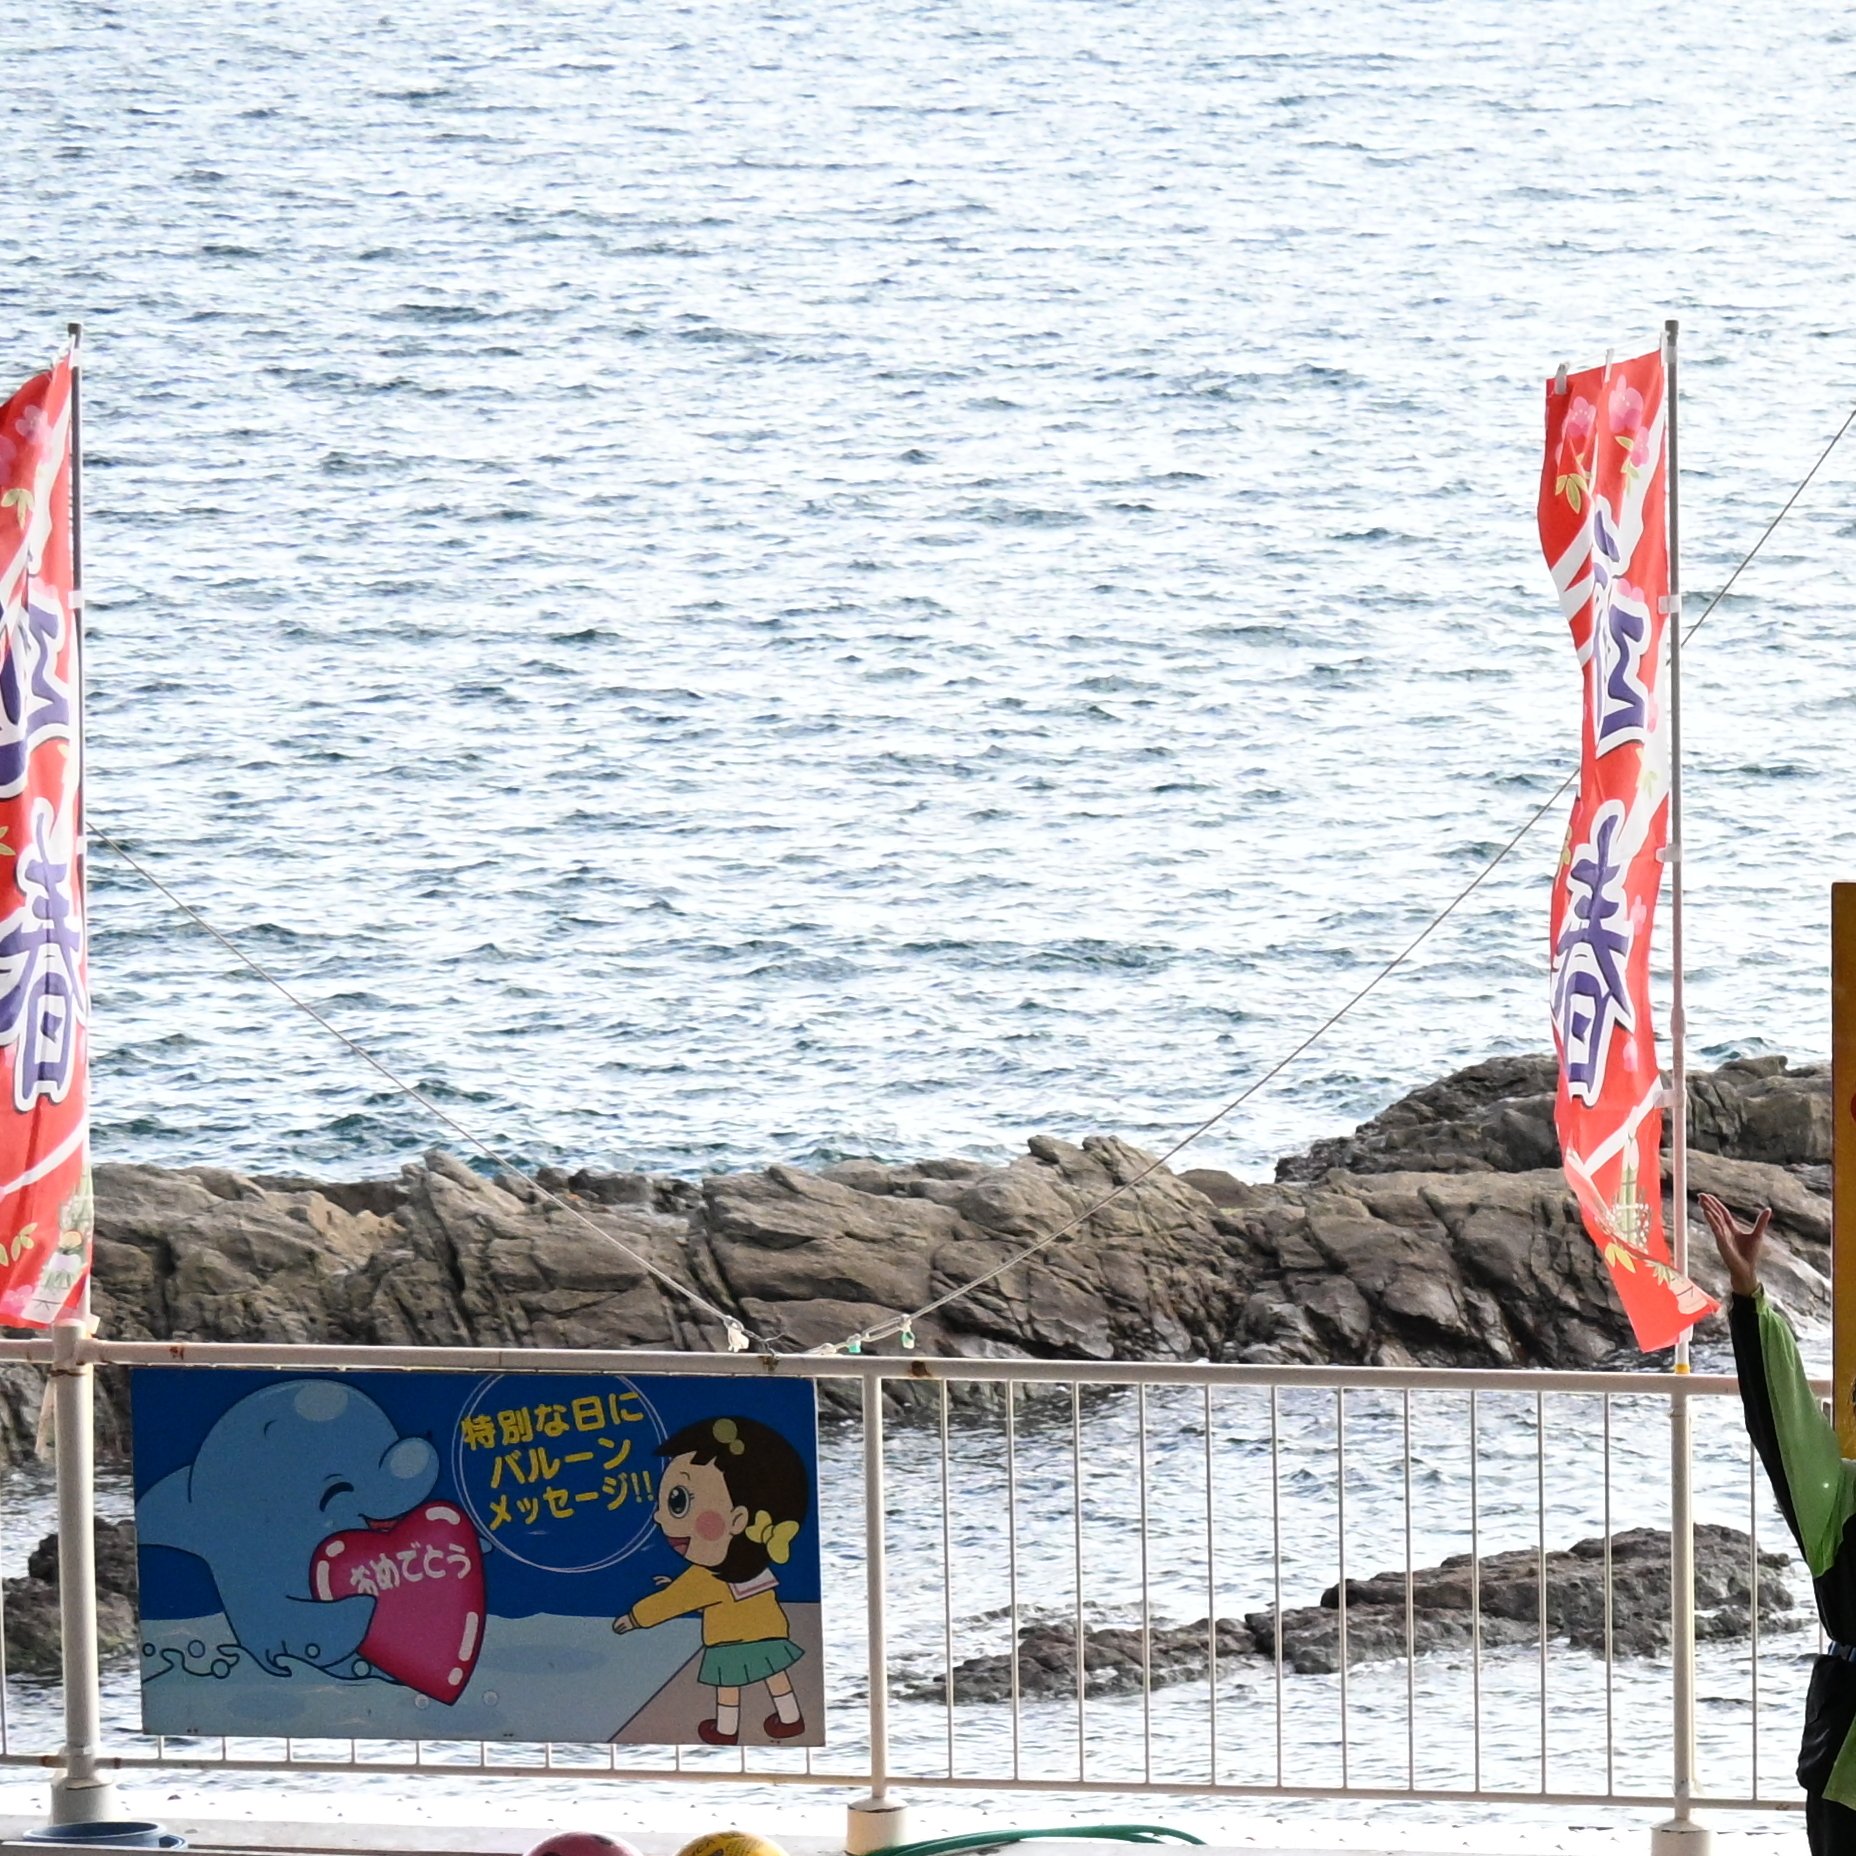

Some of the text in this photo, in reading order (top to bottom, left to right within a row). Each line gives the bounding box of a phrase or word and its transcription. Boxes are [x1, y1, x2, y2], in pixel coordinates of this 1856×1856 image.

[460, 1391, 645, 1451] 特別な日に
[489, 1438, 633, 1489] バルーン
[349, 1541, 472, 1597] おめでとう
